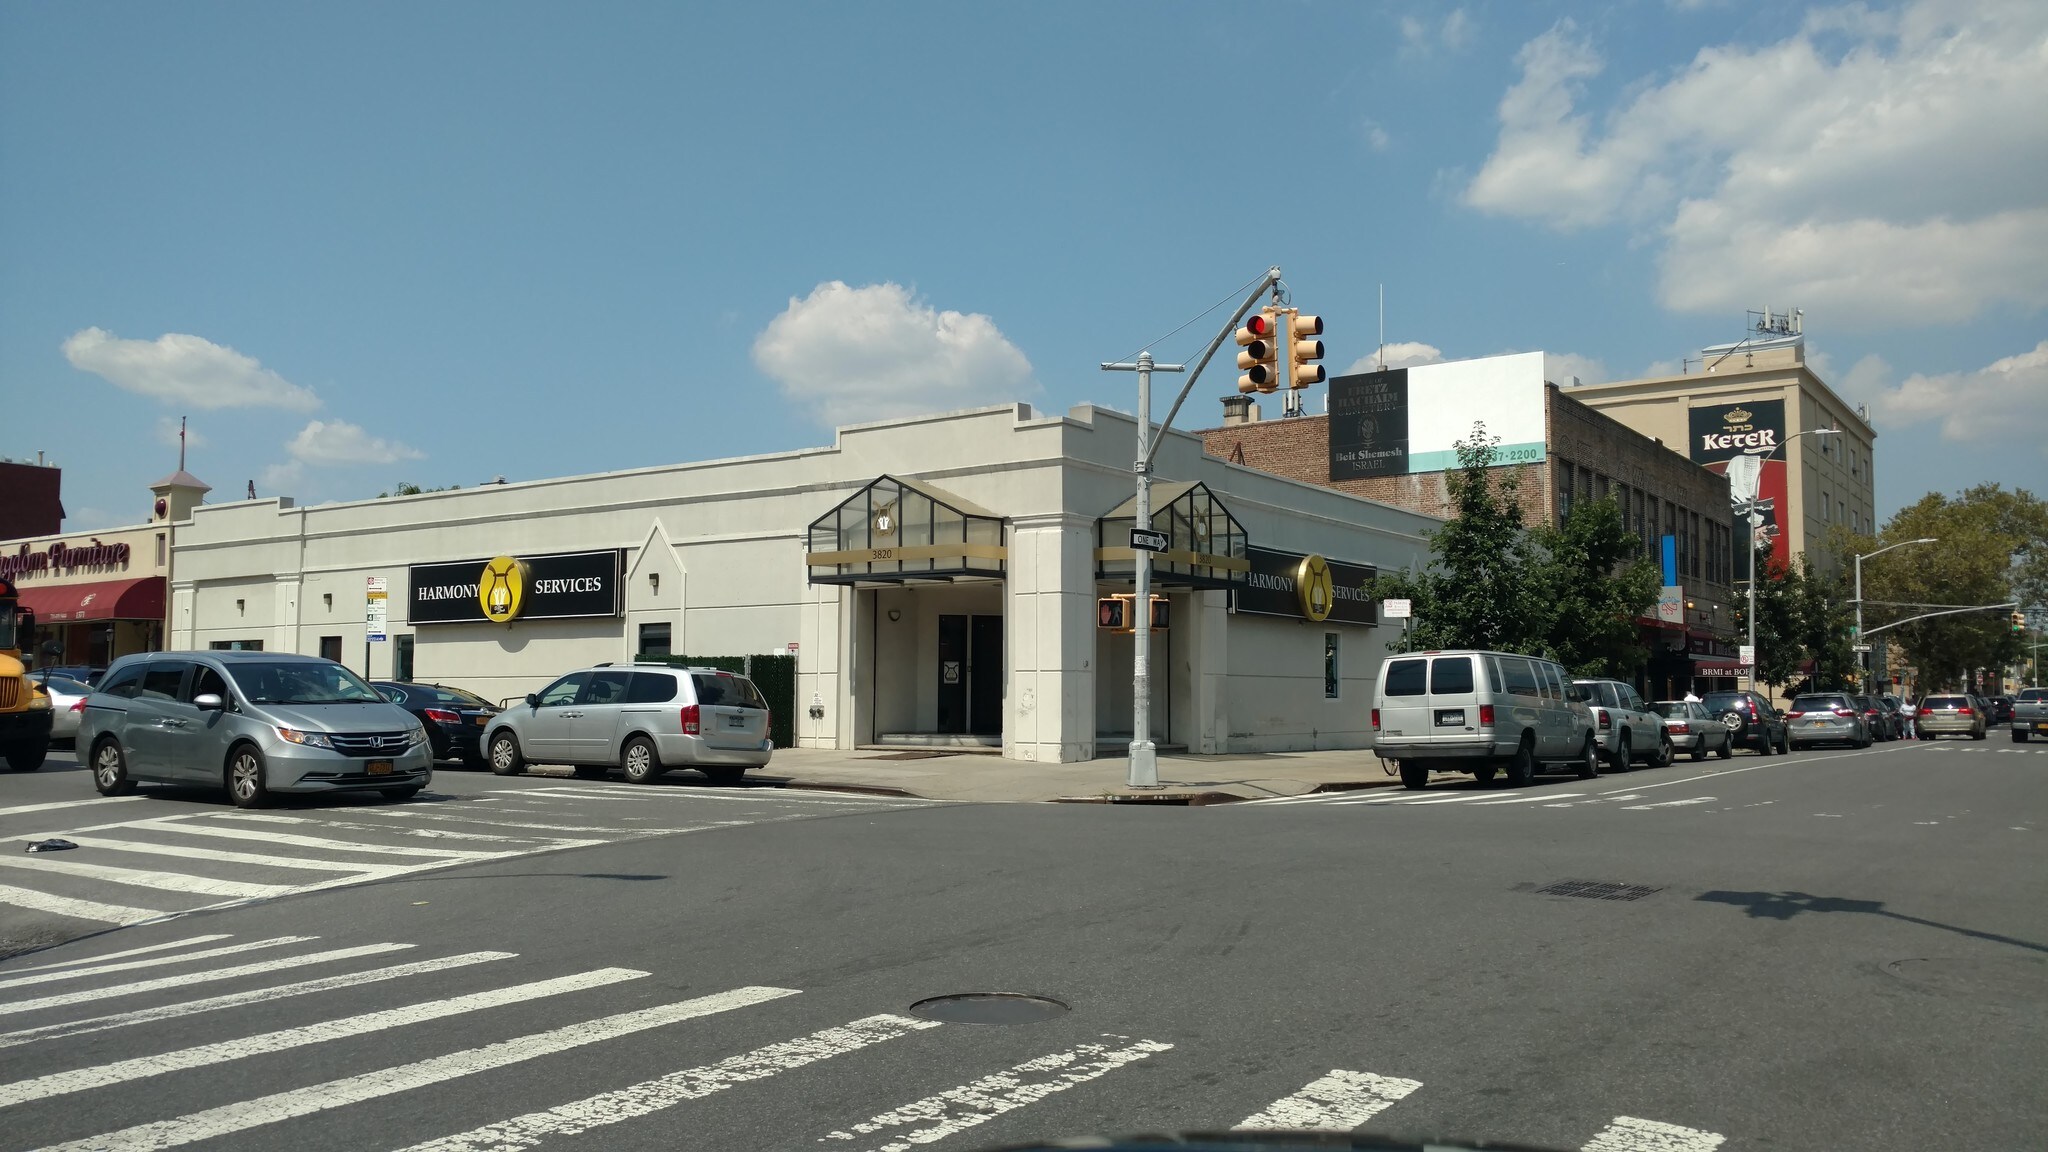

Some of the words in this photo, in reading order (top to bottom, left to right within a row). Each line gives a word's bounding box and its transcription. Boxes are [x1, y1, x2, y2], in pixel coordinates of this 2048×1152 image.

[1335, 451, 1356, 461] Beit
[1358, 447, 1403, 460] Shemesh
[1352, 459, 1386, 471] ISRAEL
[1137, 535, 1149, 544] ONE
[1153, 539, 1164, 547] WAY
[49, 538, 128, 568] Furniture
[872, 549, 892, 560] 3820
[418, 583, 481, 600] HARMONY
[535, 577, 601, 594] SERVICES
[1702, 668, 1723, 676] BRMI
